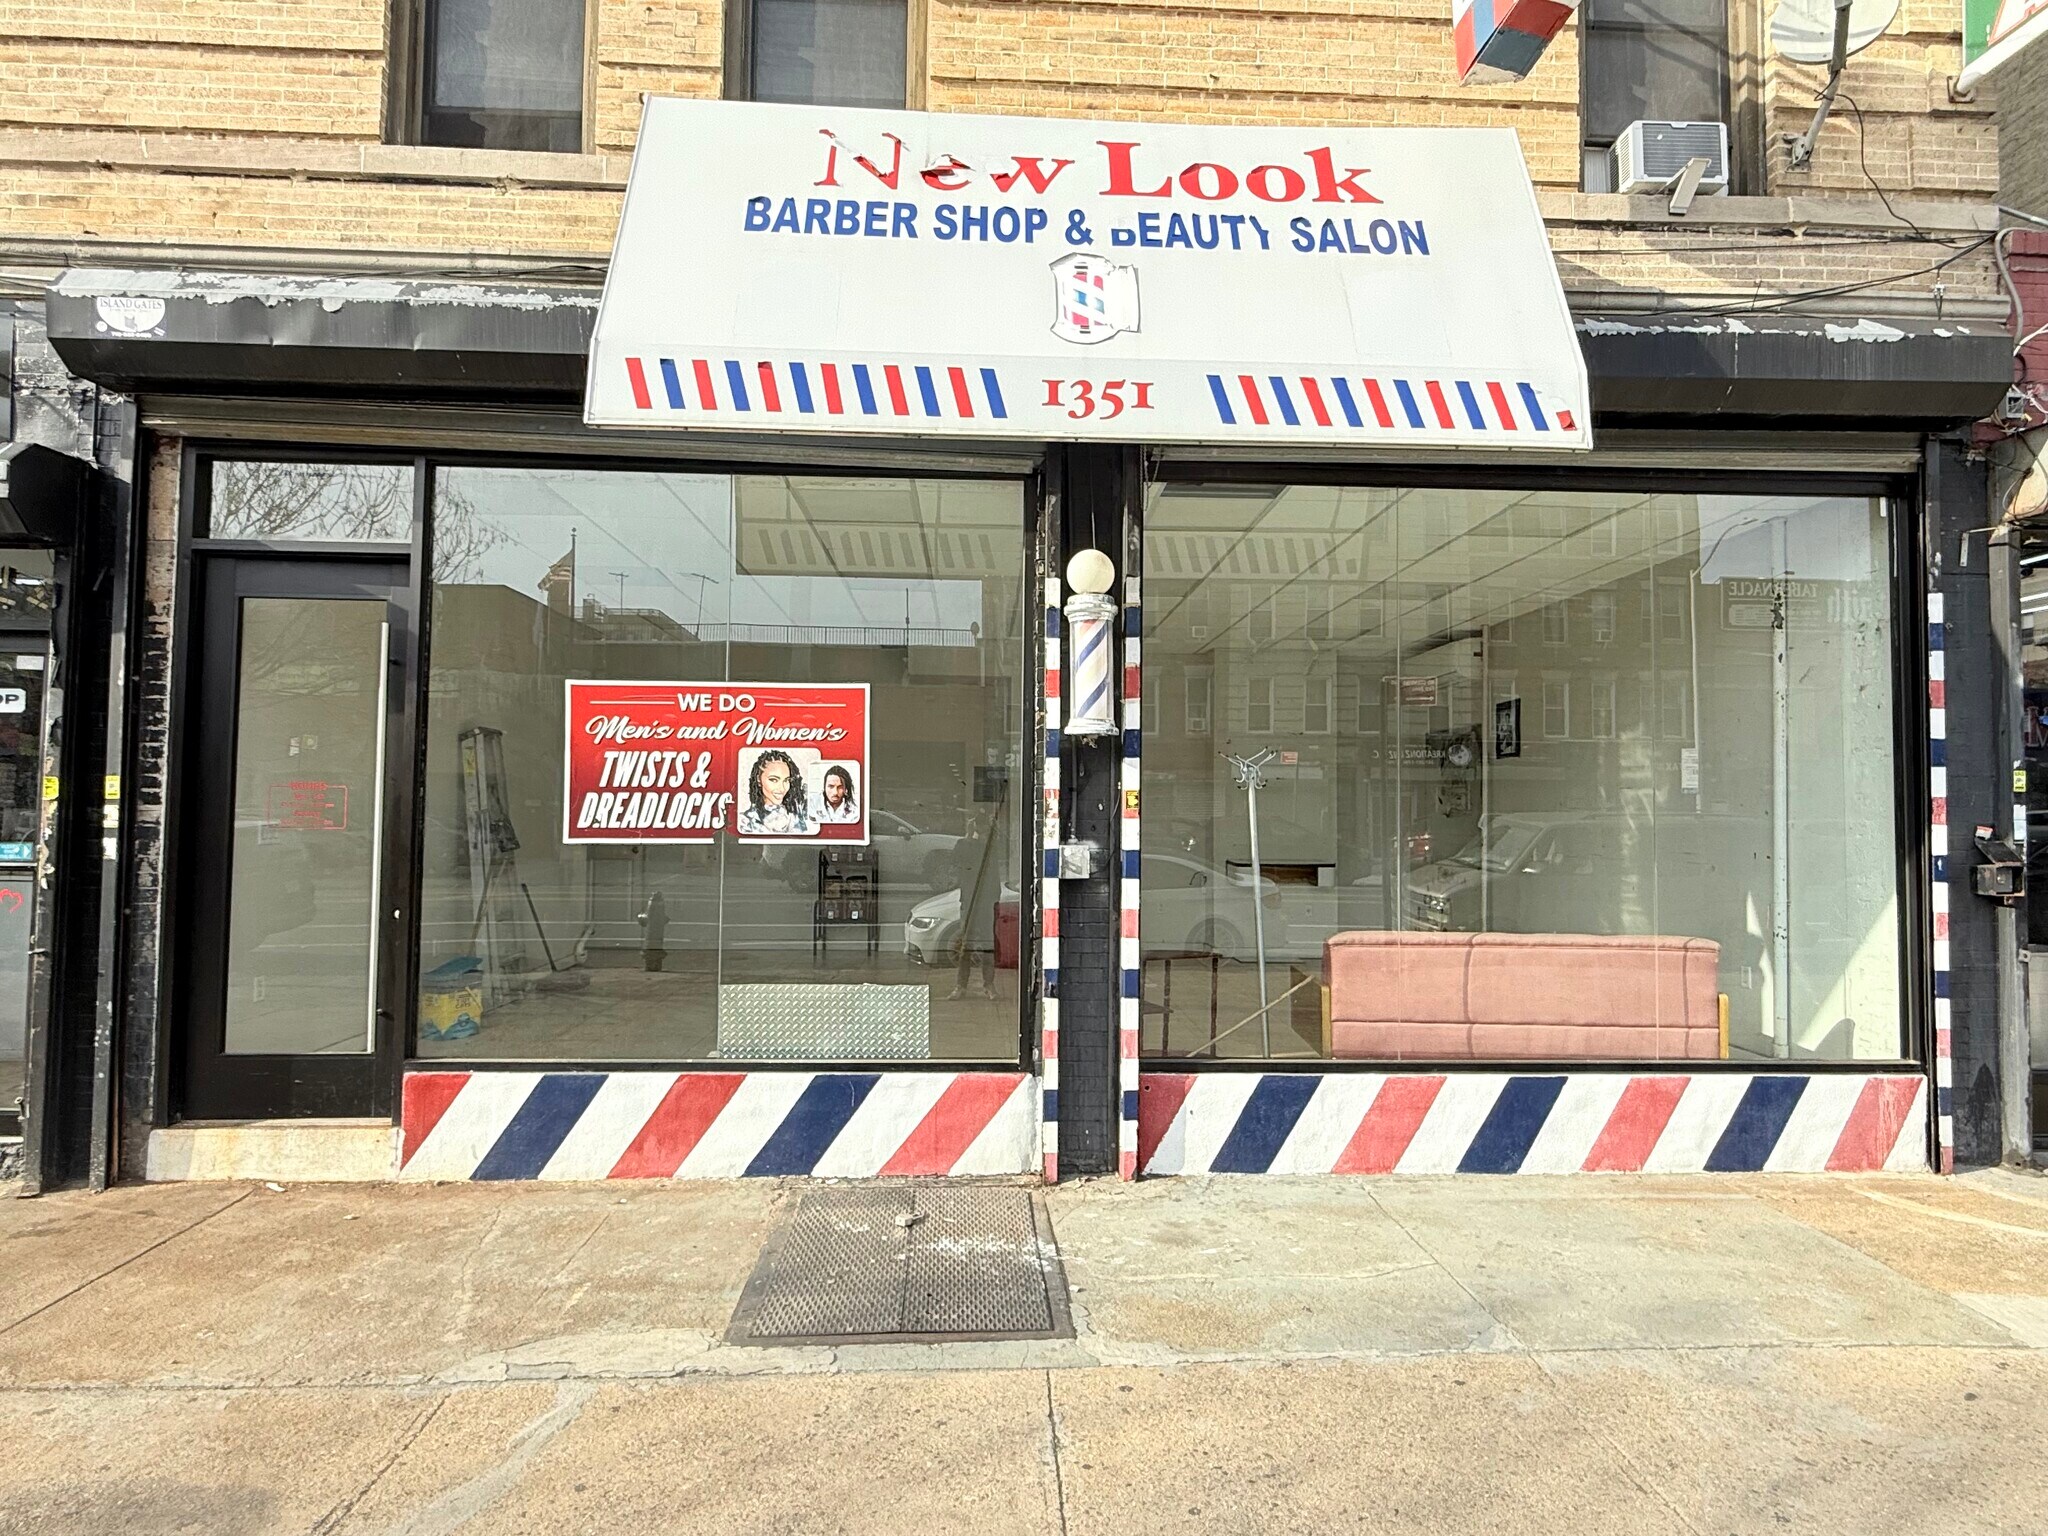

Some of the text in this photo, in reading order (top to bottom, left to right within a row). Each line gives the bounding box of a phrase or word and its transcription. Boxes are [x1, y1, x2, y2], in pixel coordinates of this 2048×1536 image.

[813, 129, 1385, 204] New Look
[743, 195, 1431, 256] BARBER SHOP & BEAUTY SALON
[1041, 378, 1155, 420] 1351
[677, 692, 757, 713] WE DO
[584, 715, 848, 745] Men's and Women's
[598, 750, 713, 789] TWISTS &
[576, 792, 735, 830] DREADLOCKS
